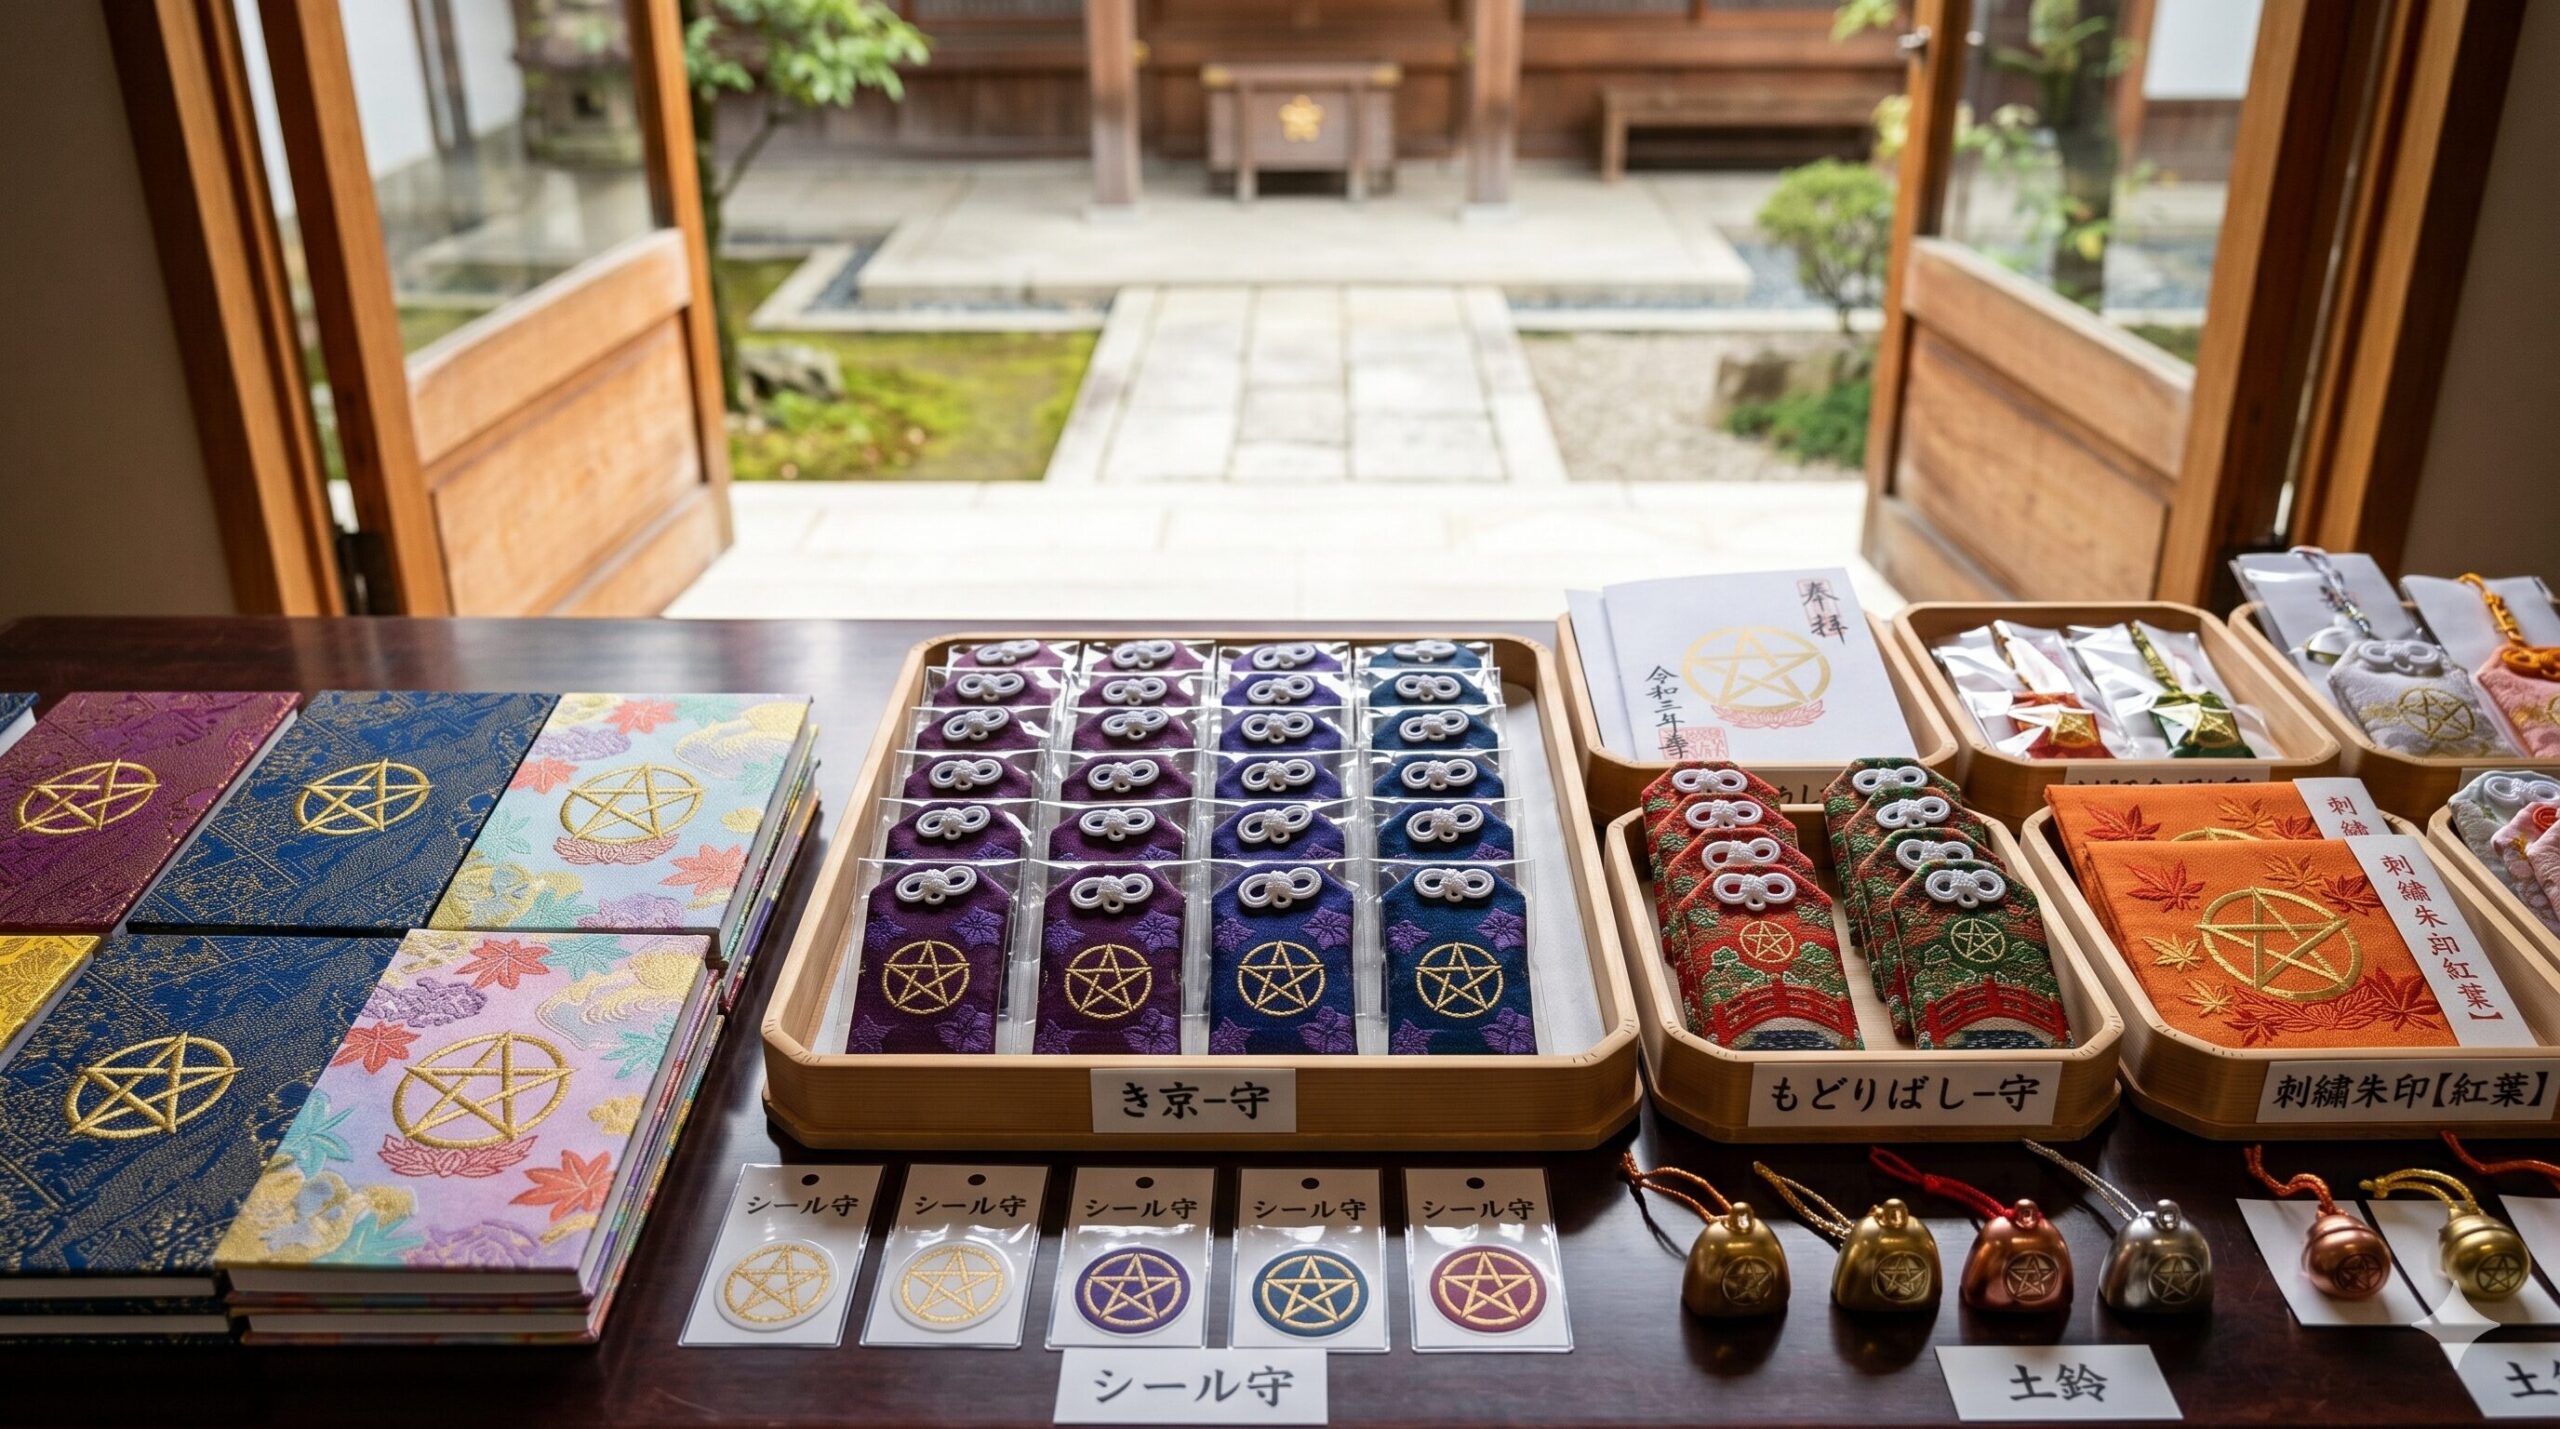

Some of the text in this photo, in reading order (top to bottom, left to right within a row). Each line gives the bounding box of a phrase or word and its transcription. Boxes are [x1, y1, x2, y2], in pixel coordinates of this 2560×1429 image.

[746, 1195, 860, 1218] シール守
[914, 1194, 1028, 1219] シール守
[1084, 1197, 1199, 1221] シール守
[1252, 1197, 1368, 1222] シール守
[1421, 1197, 1536, 1222] シール守
[1094, 1366, 1295, 1409] シール守
[2008, 1362, 2109, 1403] 土鈴
[2505, 1360, 2560, 1399] 土
